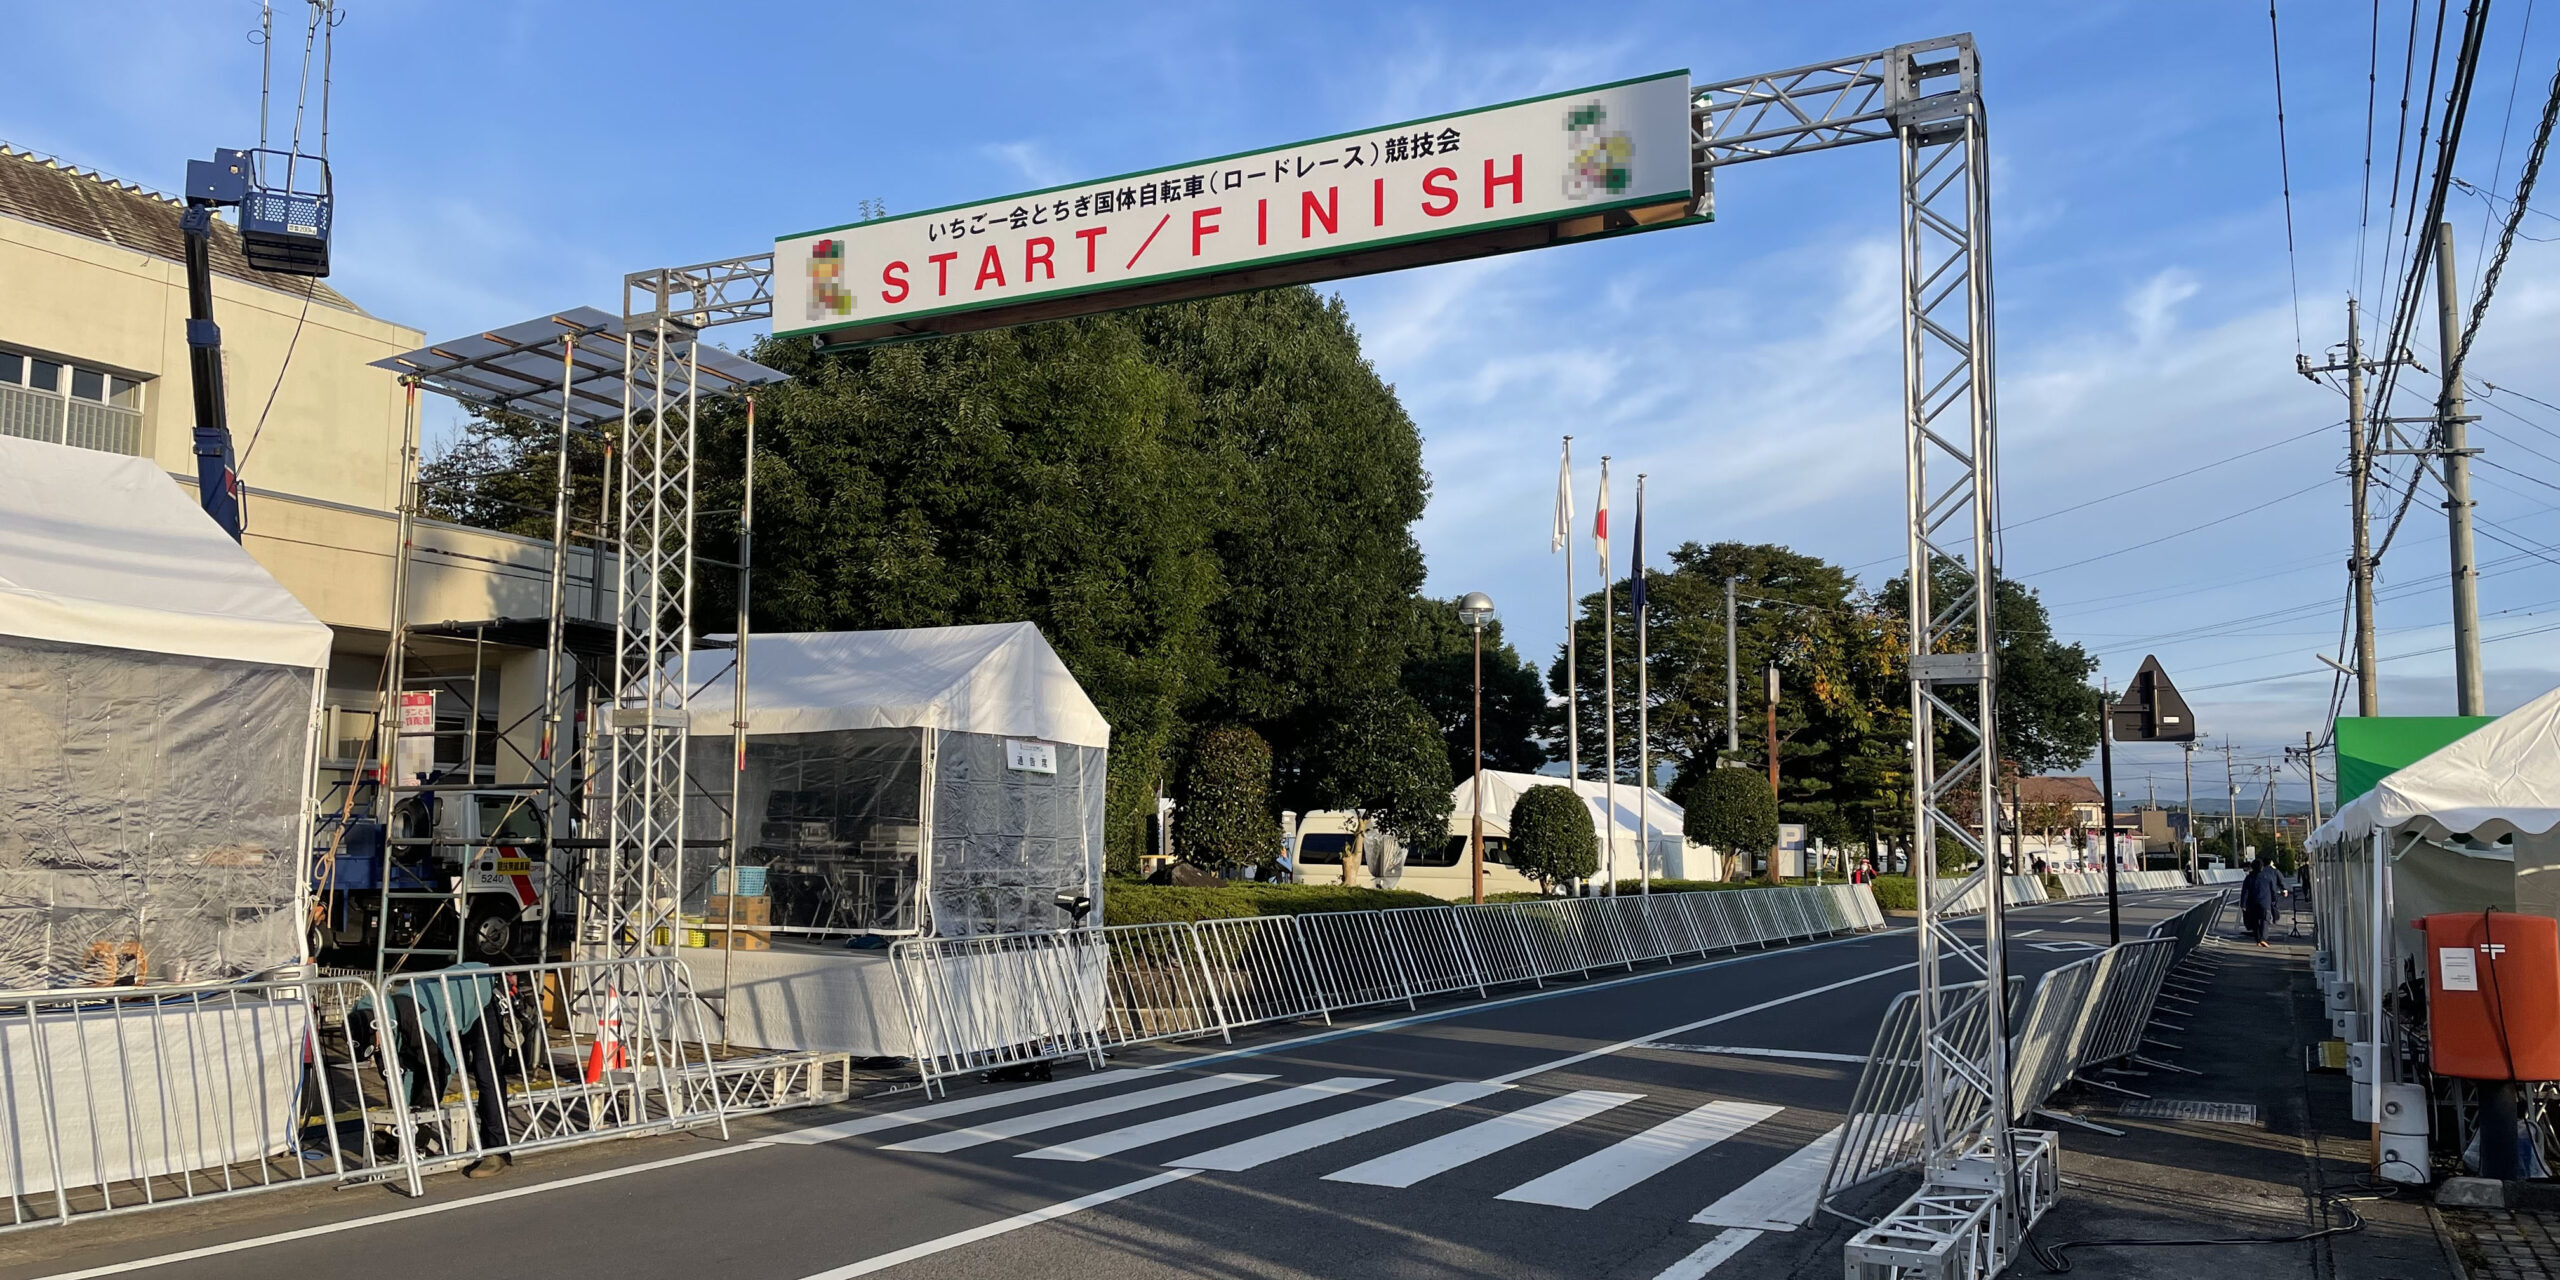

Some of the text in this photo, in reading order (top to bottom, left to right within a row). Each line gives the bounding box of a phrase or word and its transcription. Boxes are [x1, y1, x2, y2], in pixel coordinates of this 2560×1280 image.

[928, 127, 1461, 242] いちご一会とちぎ国体自転車（ロードレース）競技会
[881, 154, 1524, 304] START/FINISH
[1781, 826, 1801, 848] P
[481, 874, 504, 883] 5240
